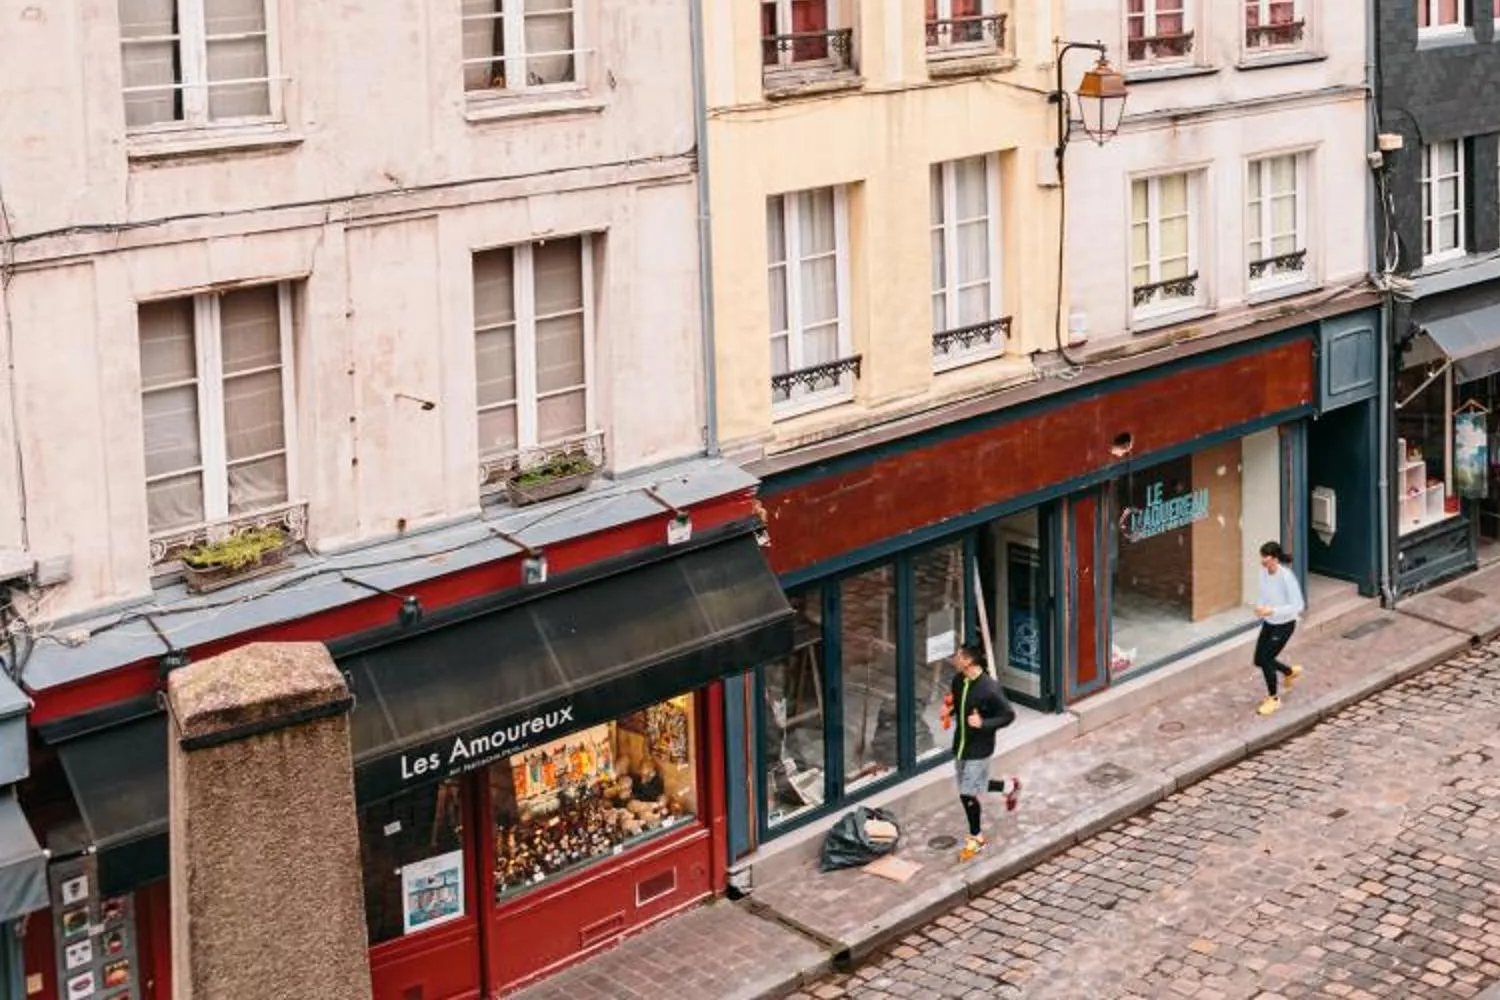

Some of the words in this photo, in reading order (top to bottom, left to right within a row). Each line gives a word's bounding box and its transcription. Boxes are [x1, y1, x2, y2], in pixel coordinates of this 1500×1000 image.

[1146, 481, 1164, 507] LE
[401, 752, 440, 780] Les
[449, 705, 575, 764] Amoureux
